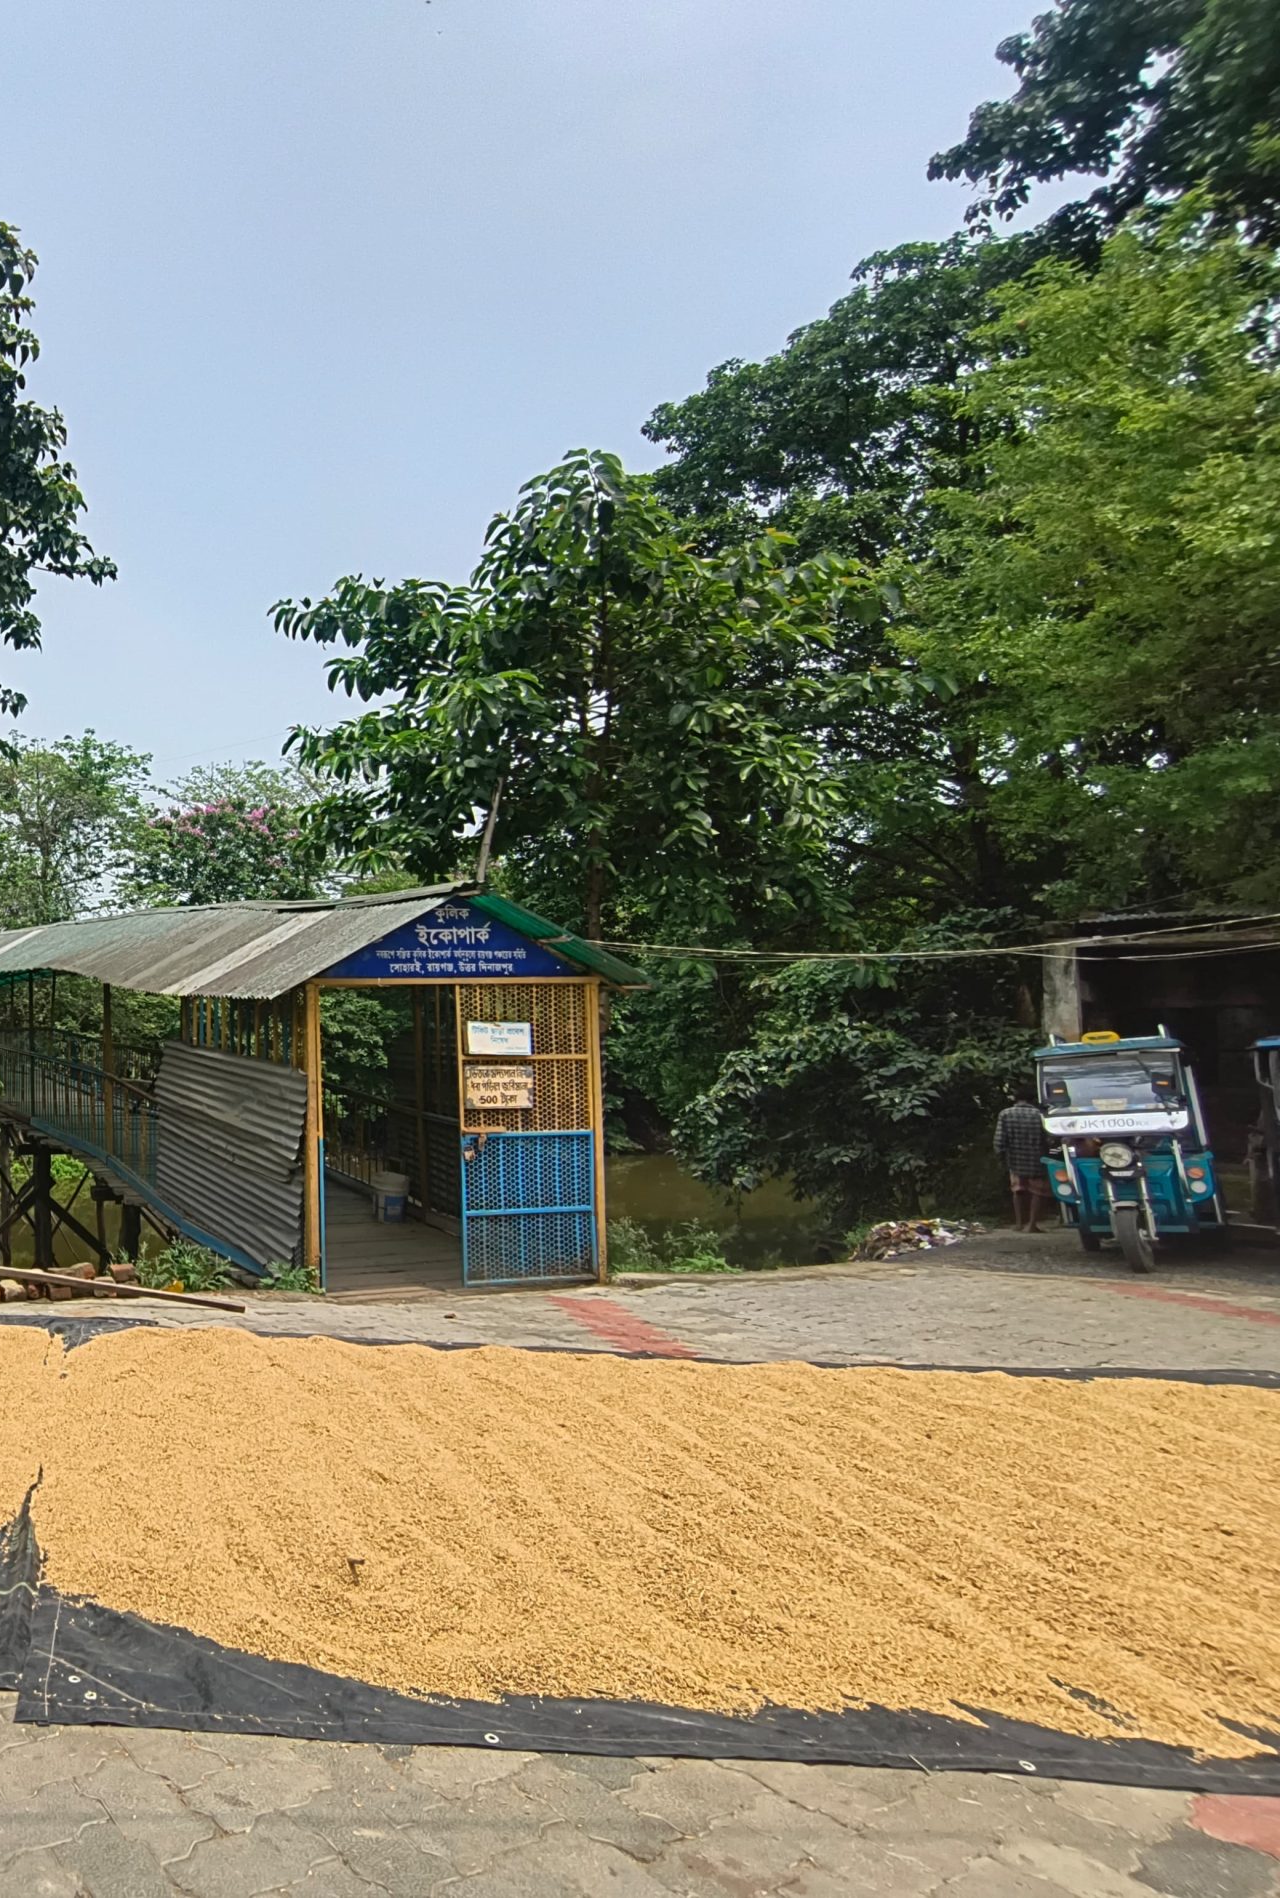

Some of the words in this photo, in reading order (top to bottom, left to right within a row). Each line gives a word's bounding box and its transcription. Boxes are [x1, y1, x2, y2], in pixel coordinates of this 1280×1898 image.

[434, 904, 470, 924] কুলিক
[415, 921, 491, 947] ইকোপার্ক
[479, 1095, 498, 1104] 500
[1080, 1118, 1135, 1130] JK1000
